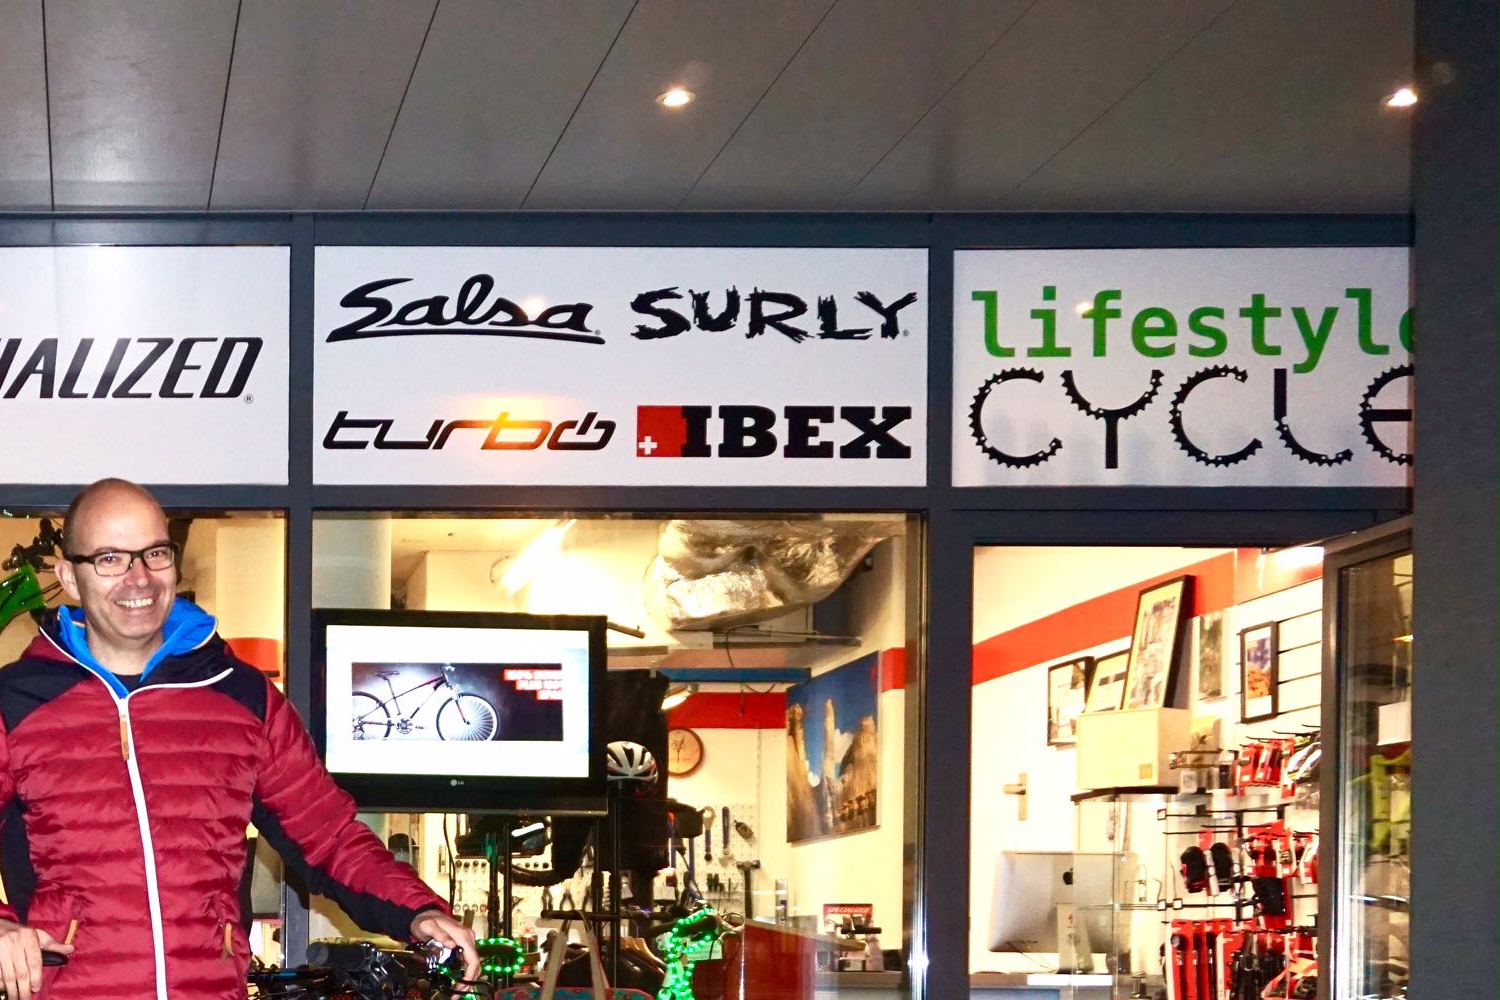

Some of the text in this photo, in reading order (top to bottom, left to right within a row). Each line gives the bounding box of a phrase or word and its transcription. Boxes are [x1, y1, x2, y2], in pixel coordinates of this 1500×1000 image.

[326, 274, 605, 344] Salsa
[630, 284, 917, 343] SURLY
[322, 411, 617, 451] turbo
[680, 405, 912, 459] IBEX
[968, 363, 1414, 469] CYCLE
